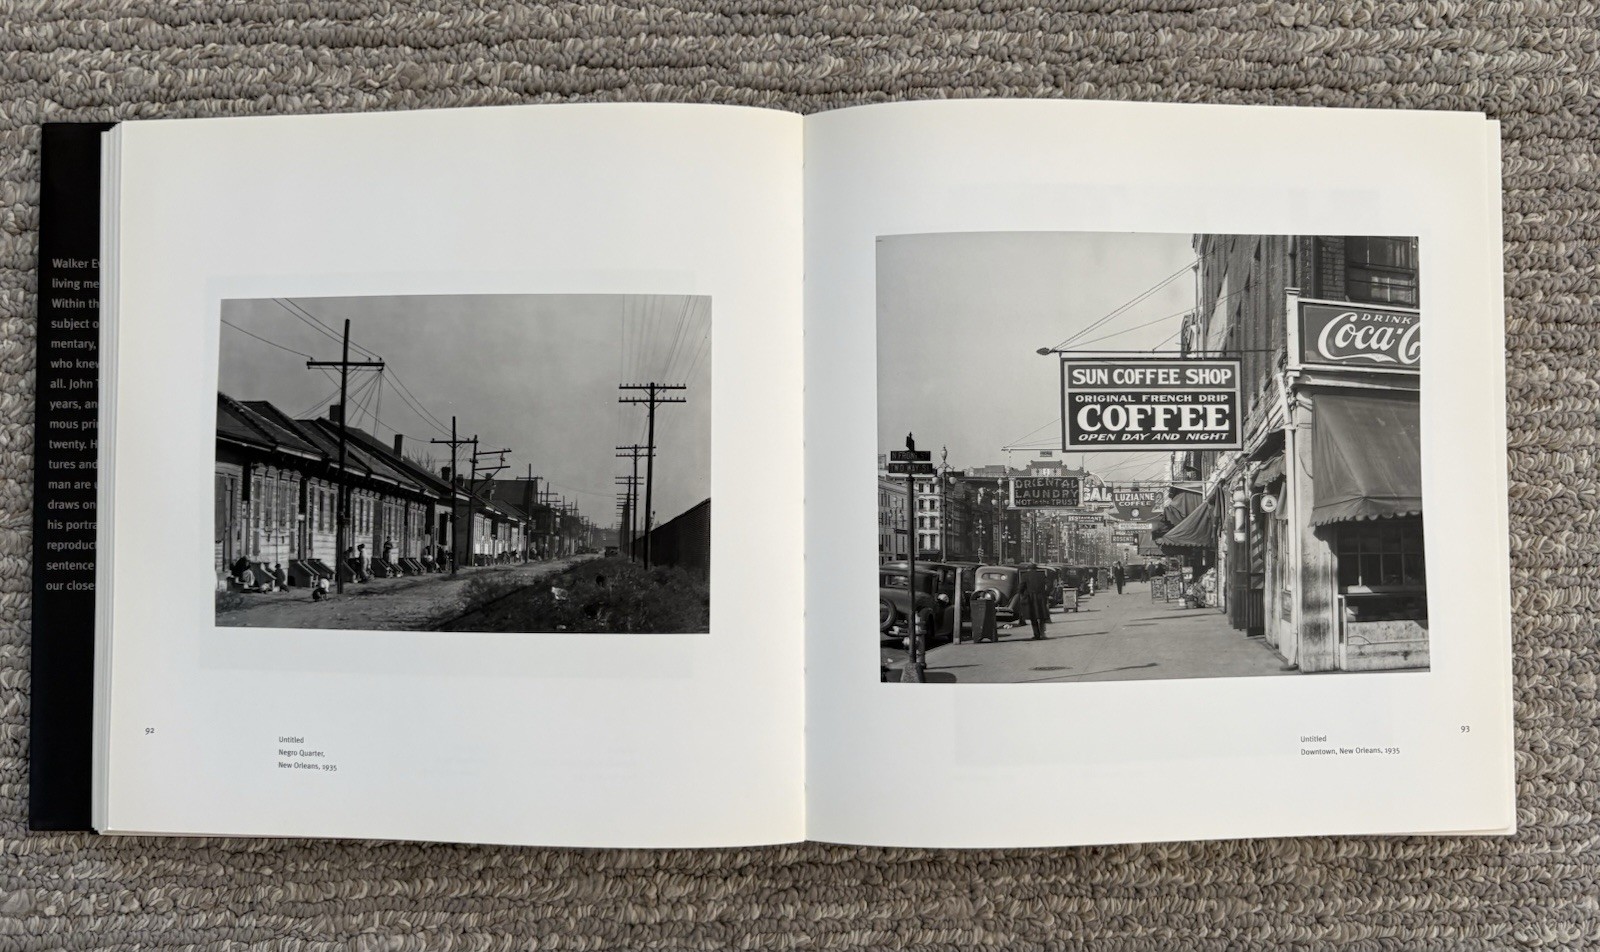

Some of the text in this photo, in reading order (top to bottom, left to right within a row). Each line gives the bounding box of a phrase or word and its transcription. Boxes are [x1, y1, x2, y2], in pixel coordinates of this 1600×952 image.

[52, 258, 99, 269] Walker E
[52, 278, 80, 290] living
[51, 299, 85, 309] Within
[51, 318, 89, 330] subject
[1360, 313, 1413, 325] DRINK
[50, 339, 96, 350] mentary,
[50, 359, 73, 369] who
[1072, 368, 1232, 385] SUN COFFEE SHOP
[50, 379, 66, 389] all.
[69, 379, 93, 390] John
[1075, 394, 1229, 403] ORIGINAL FRENCH DRIP
[50, 400, 82, 411] years,
[1077, 404, 1230, 431] COFFEE
[49, 421, 78, 429] mous
[1078, 432, 1229, 441] OPEN DAY AND NIGHT
[49, 440, 87, 451] twenty.
[48, 460, 76, 469] tures
[48, 481, 71, 489] man
[74, 481, 91, 489] are
[1015, 478, 1078, 488] ORIENTAL
[1015, 489, 1078, 499] LAUNDRY
[1115, 492, 1155, 501] LUZIANNE
[47, 500, 96, 510] draws on
[47, 520, 63, 530] his
[46, 561, 94, 571] sentence
[45, 582, 64, 591] our
[145, 727, 155, 735] 92
[1460, 725, 1471, 733] 93
[278, 736, 305, 744] Untitled
[1300, 735, 1327, 743] Untitled
[278, 749, 326, 758] Negro Quarter,
[1300, 748, 1338, 756] Downtown,
[1339, 747, 1354, 755] New
[1384, 747, 1400, 755] 1935
[294, 762, 321, 770] Orleans,
[322, 764, 338, 772] 1935
